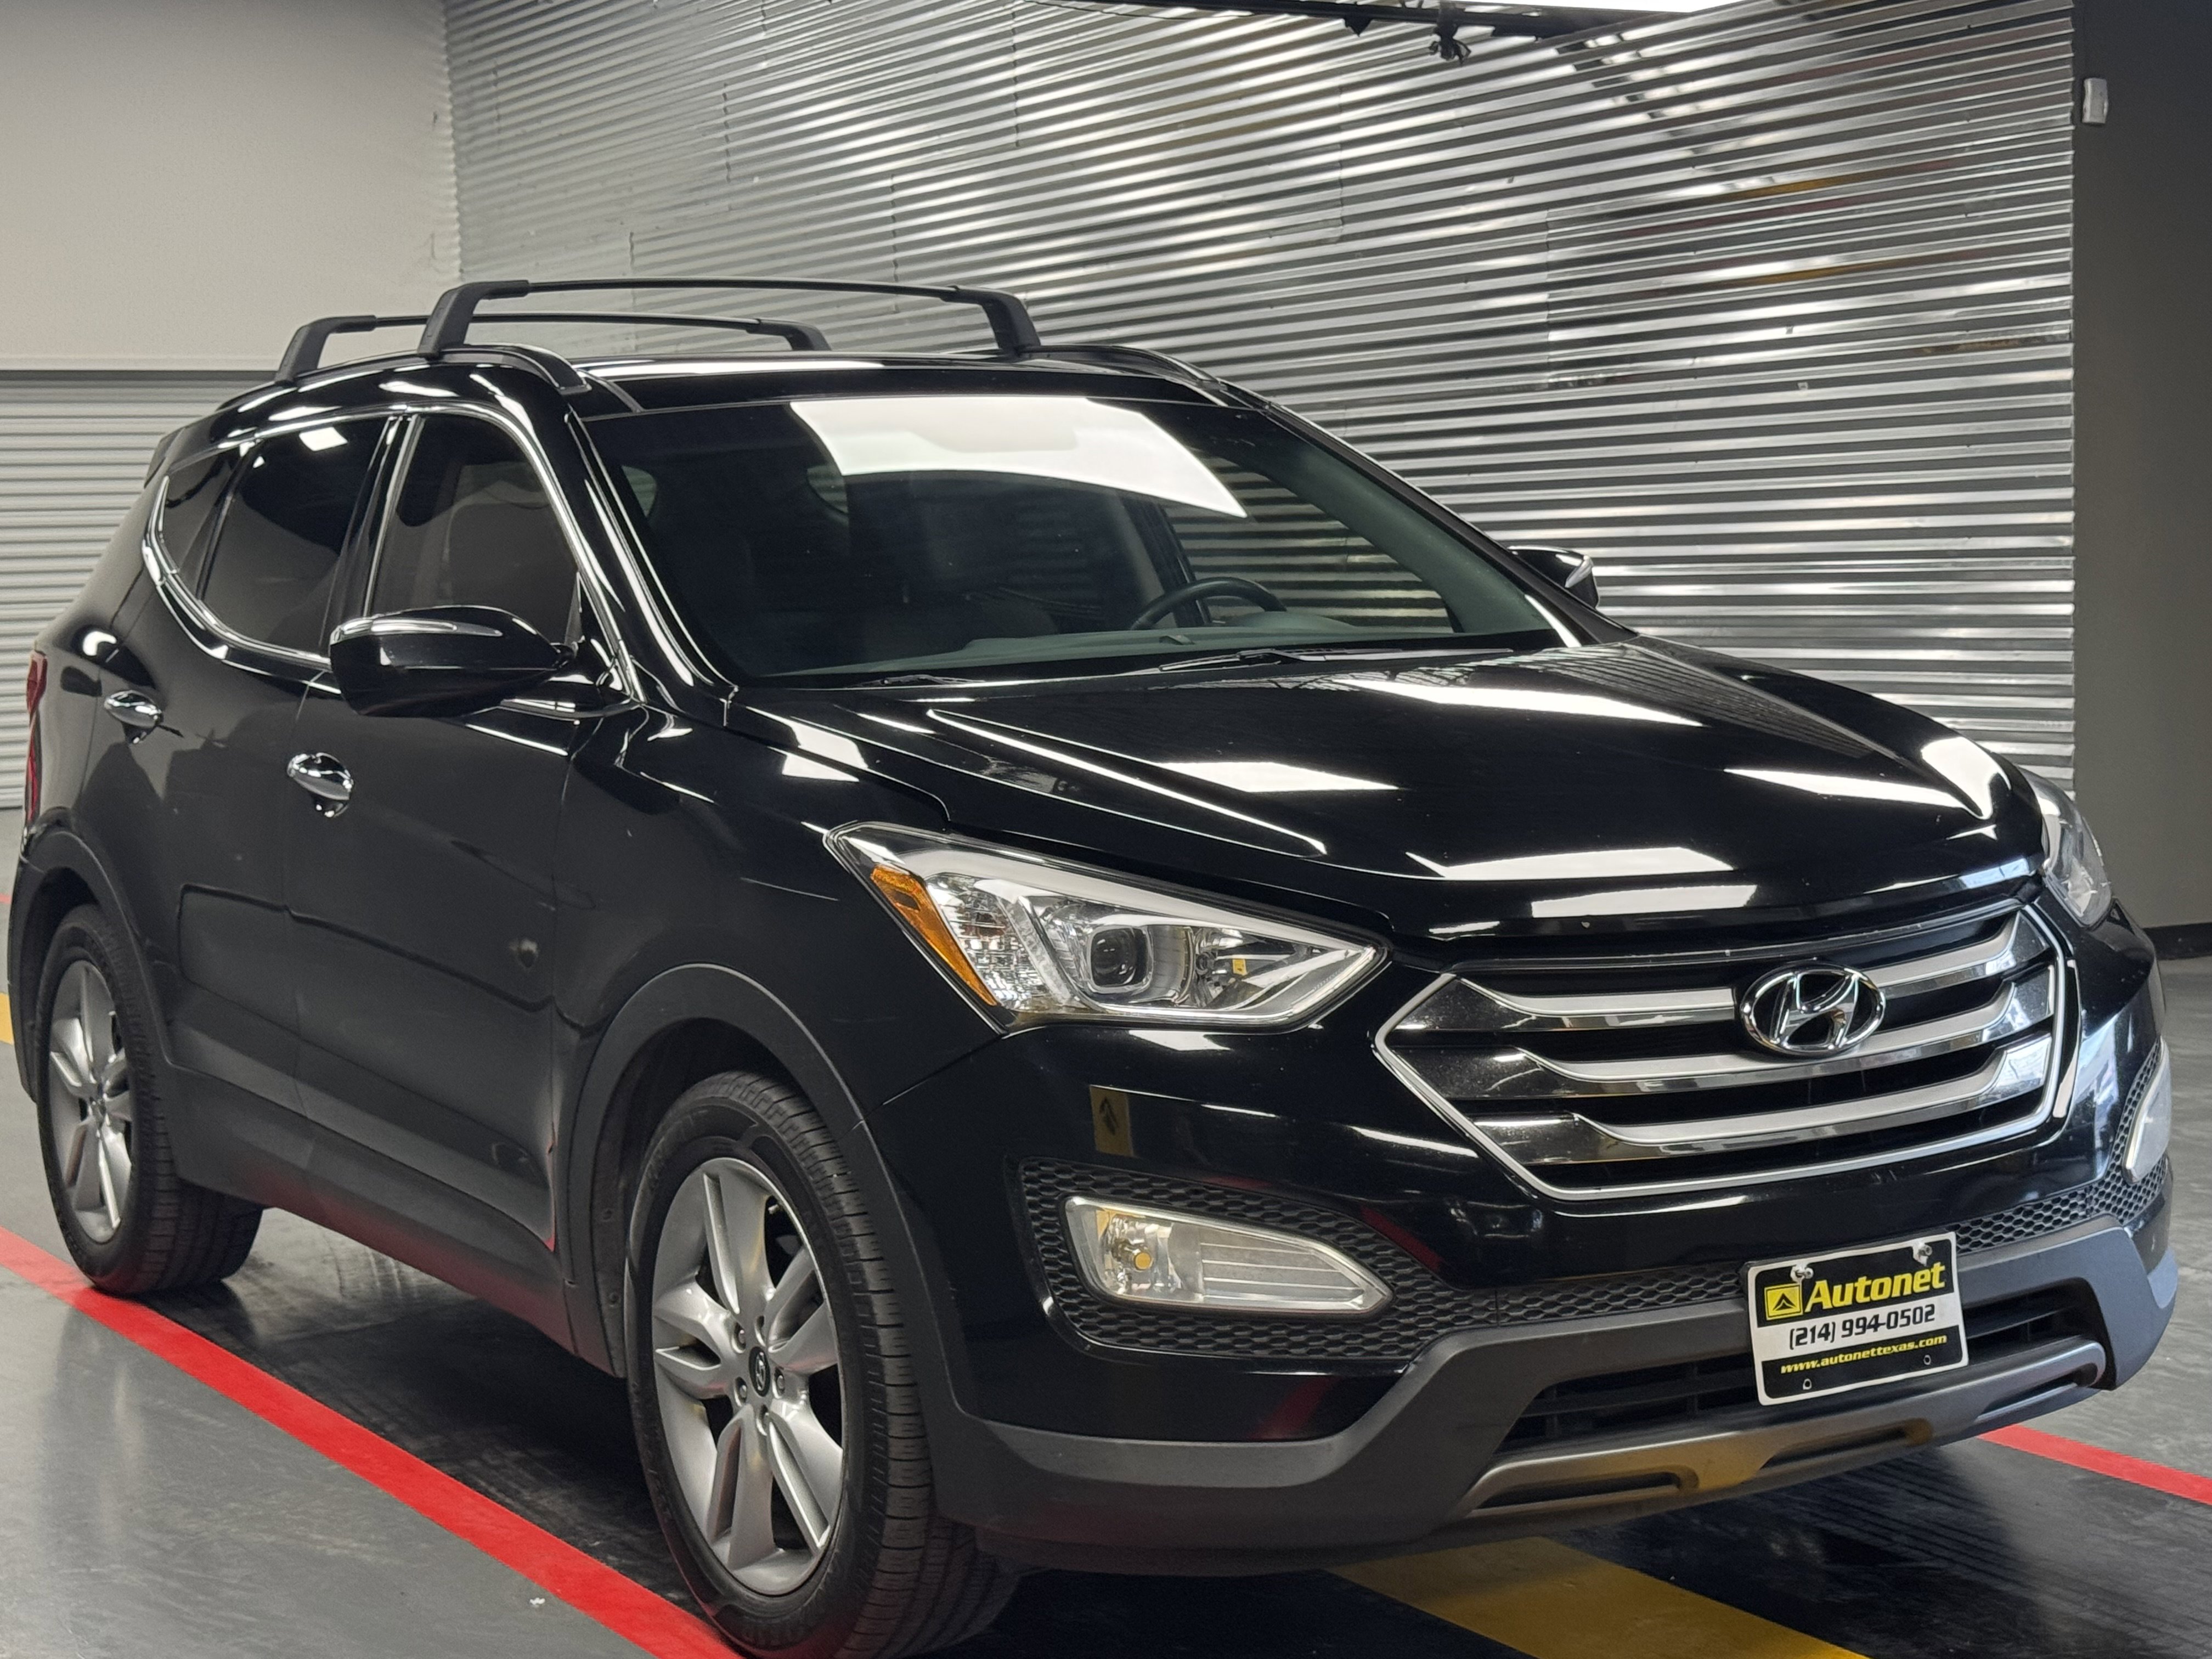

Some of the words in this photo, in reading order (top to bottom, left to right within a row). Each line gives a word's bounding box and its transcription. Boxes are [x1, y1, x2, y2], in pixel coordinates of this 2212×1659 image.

[1804, 1262, 1946, 1313] Autonet
[1789, 1321, 1836, 1350] (214)
[1841, 1304, 1936, 1338] 994-0502
[1780, 1335, 1947, 1374] www.autonettexas.com
